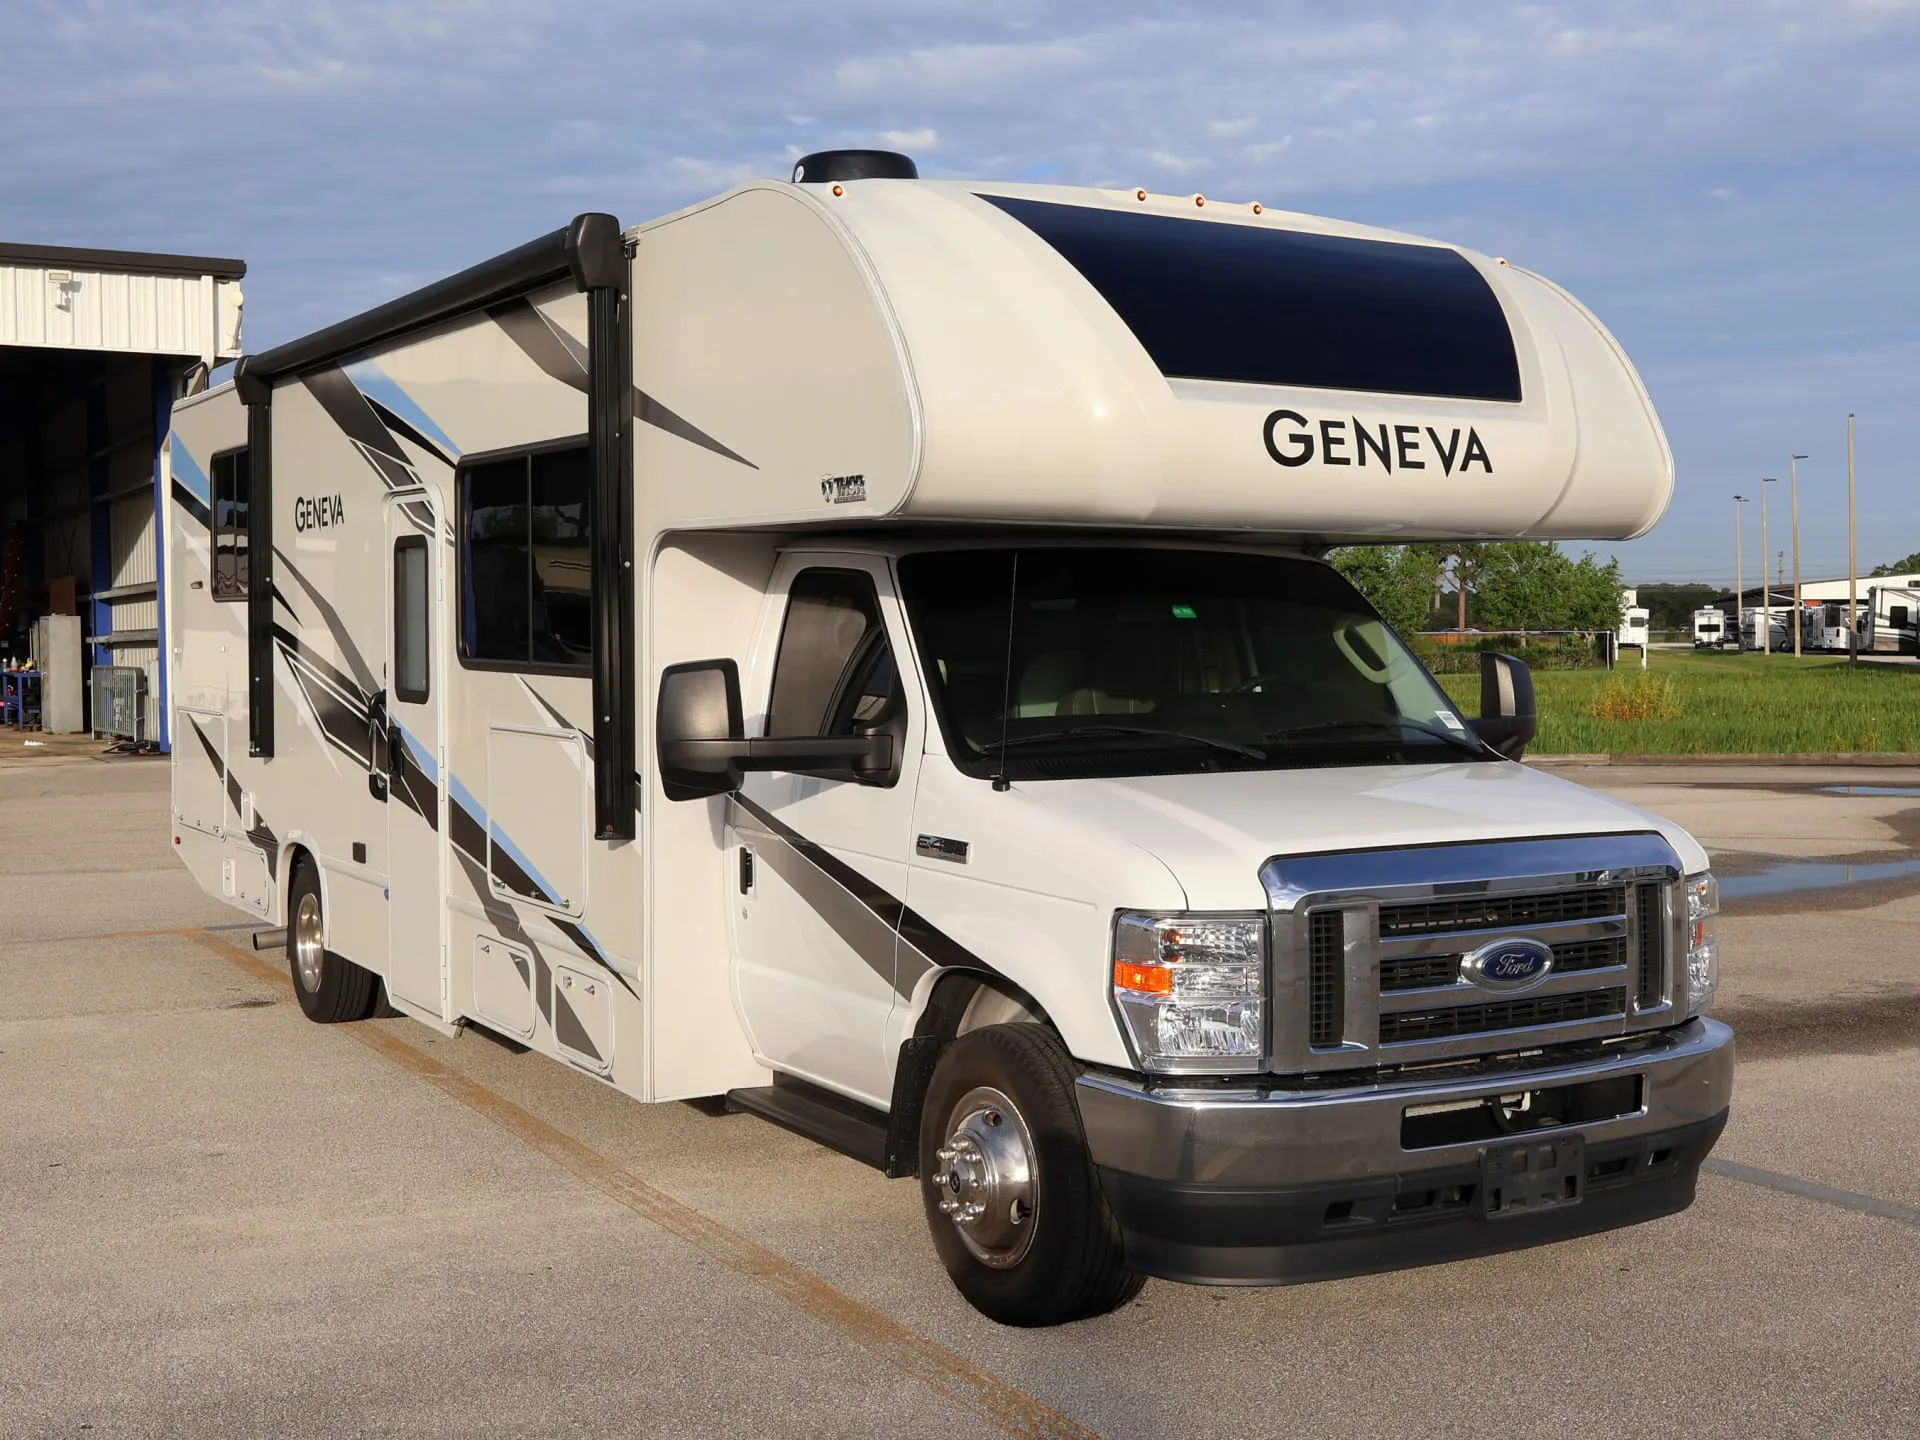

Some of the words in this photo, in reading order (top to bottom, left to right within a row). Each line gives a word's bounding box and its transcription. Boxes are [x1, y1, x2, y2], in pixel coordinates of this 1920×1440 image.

[1263, 409, 1493, 478] GENEVA
[294, 492, 345, 533] GENEVA
[1496, 953, 1534, 976] Ford
